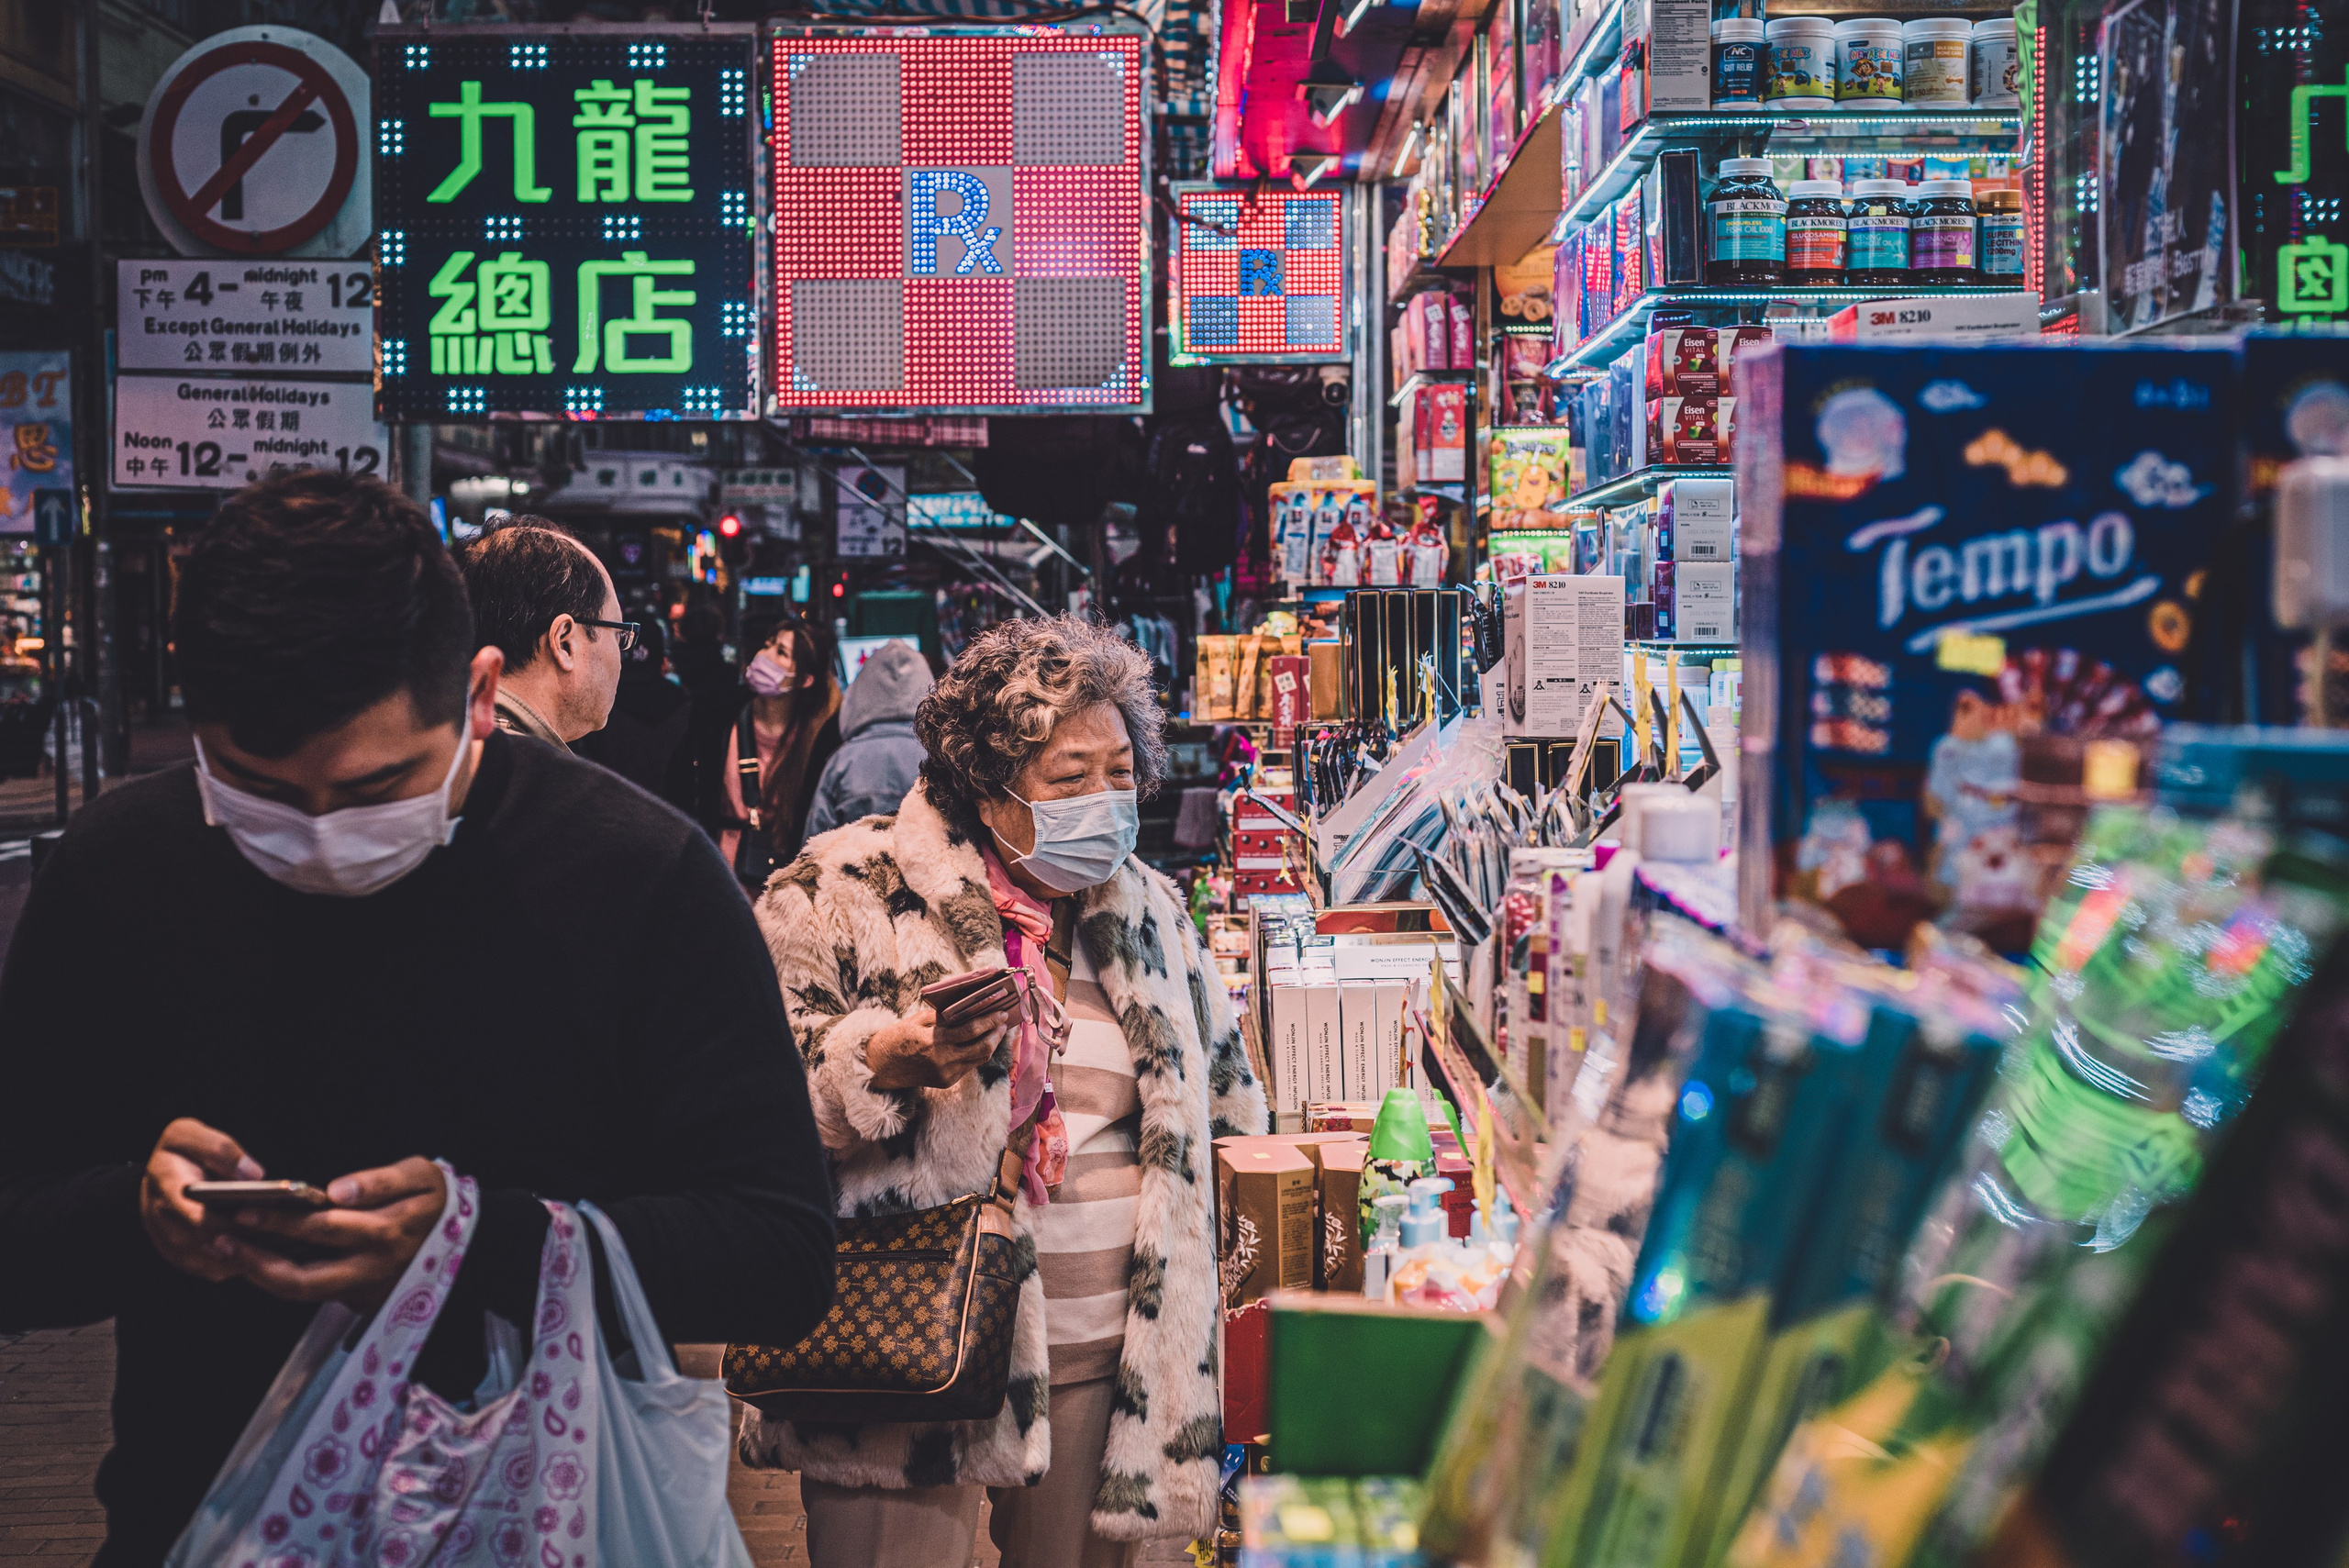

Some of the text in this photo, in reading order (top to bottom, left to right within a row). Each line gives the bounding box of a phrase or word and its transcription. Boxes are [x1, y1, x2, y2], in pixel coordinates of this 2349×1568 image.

[1849, 49, 1887, 60] CHEWABLE
[1724, 62, 1753, 72] GUT RELIEF
[428, 79, 696, 203] 九龍
[1726, 202, 1786, 212] BLACKMORES
[1791, 218, 1842, 227] BLACKMORES
[1854, 217, 1904, 227] BLACKMORES
[1916, 217, 1966, 227] BLACKMORES
[1986, 248, 2016, 256] 1200mg
[140, 269, 168, 285] pm
[243, 268, 317, 286] midnight
[327, 272, 372, 307] 12
[133, 288, 304, 312] 下午 午夜
[428, 250, 696, 375] 總店
[1870, 308, 1932, 325] 3M 8210
[144, 316, 361, 338] Except General Holidays
[184, 340, 322, 363] 公眾假期例外
[1684, 338, 1705, 347] Eisen
[1739, 338, 1759, 346] Eisen
[177, 383, 330, 407] General Holidays
[207, 407, 300, 431] 公眾假期
[1684, 406, 1705, 414] Eisen
[124, 431, 173, 450] Noon
[253, 437, 328, 456] midnight
[334, 445, 380, 475] 12
[126, 456, 169, 478] 中午
[1847, 504, 2133, 629] Tempo
